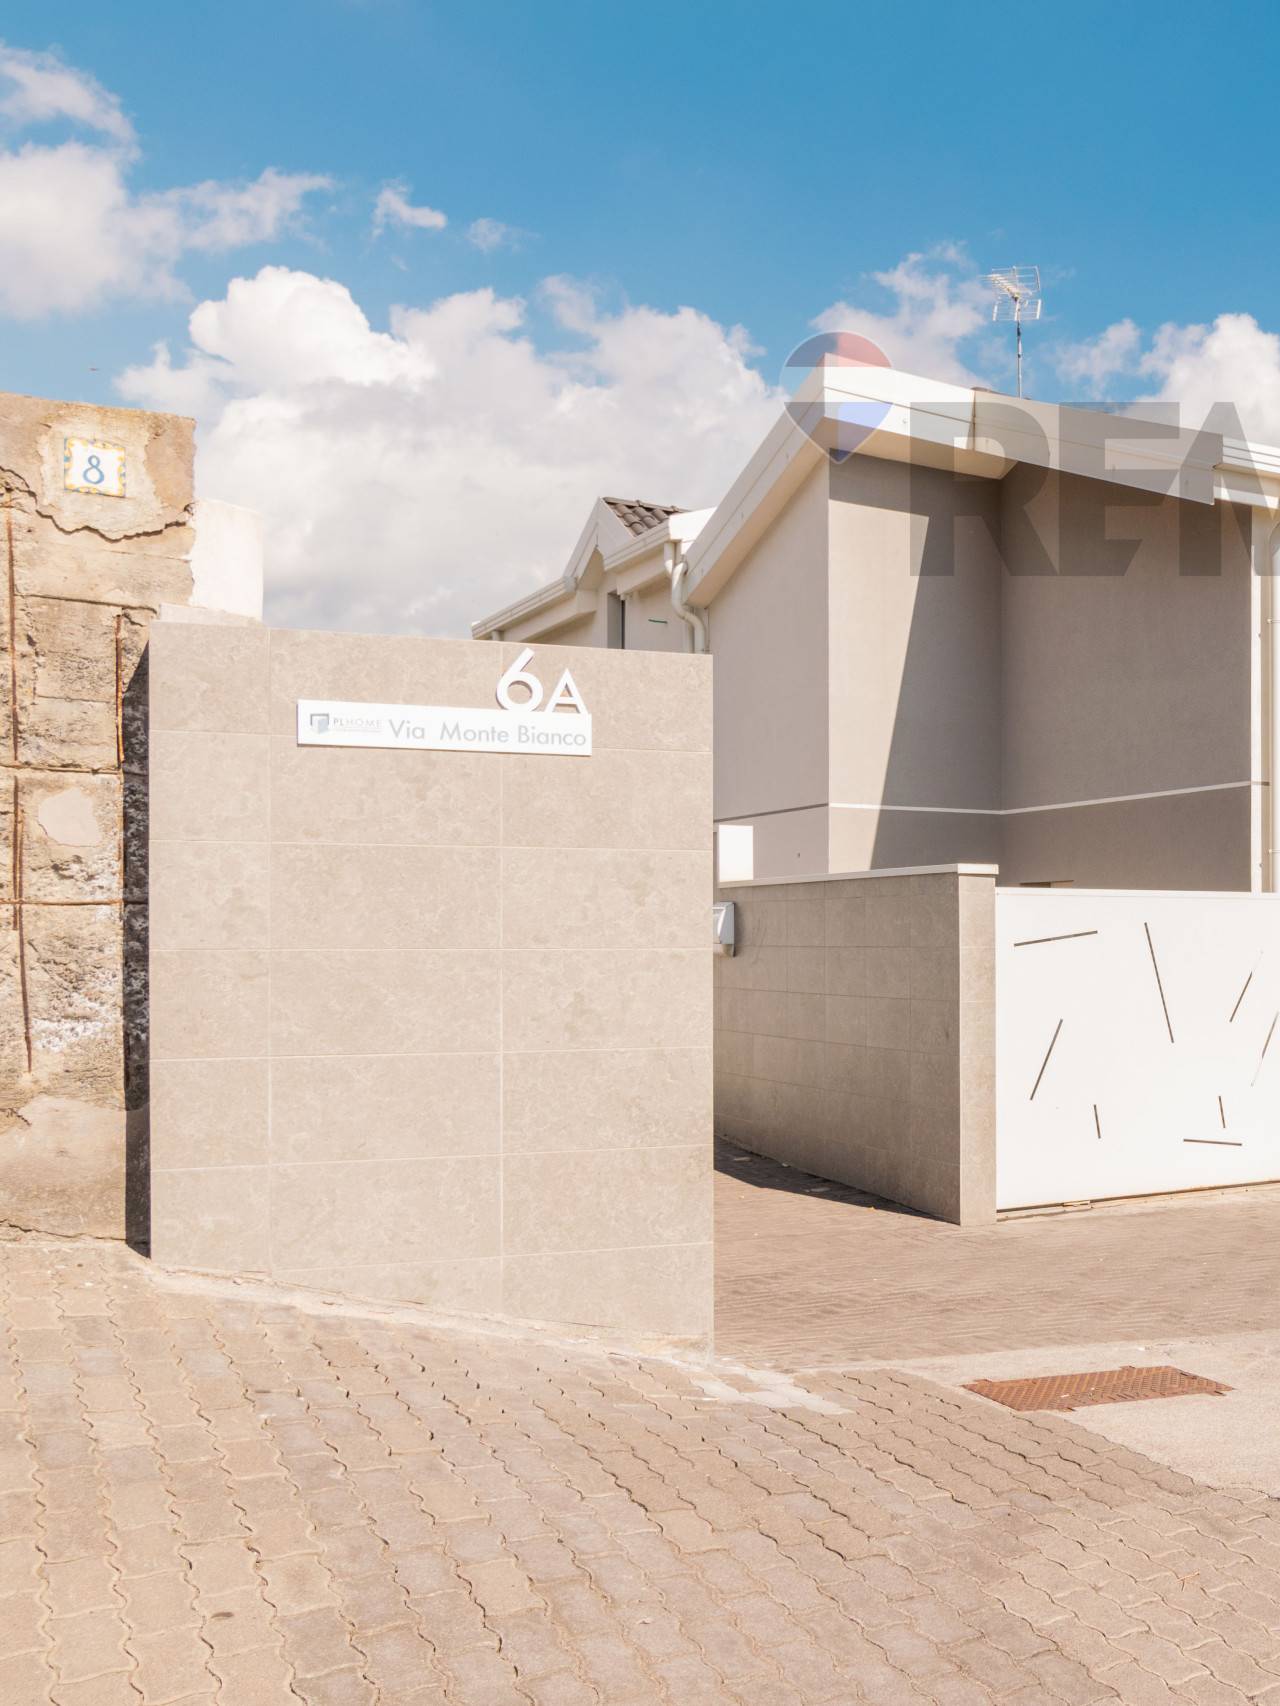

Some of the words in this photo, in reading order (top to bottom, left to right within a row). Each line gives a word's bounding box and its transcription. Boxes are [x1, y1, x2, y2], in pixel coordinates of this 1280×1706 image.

[83, 454, 105, 485] 8
[496, 647, 590, 713] 6A
[388, 719, 425, 740] Via
[440, 721, 510, 744] Monte
[517, 724, 587, 747] Bianco
